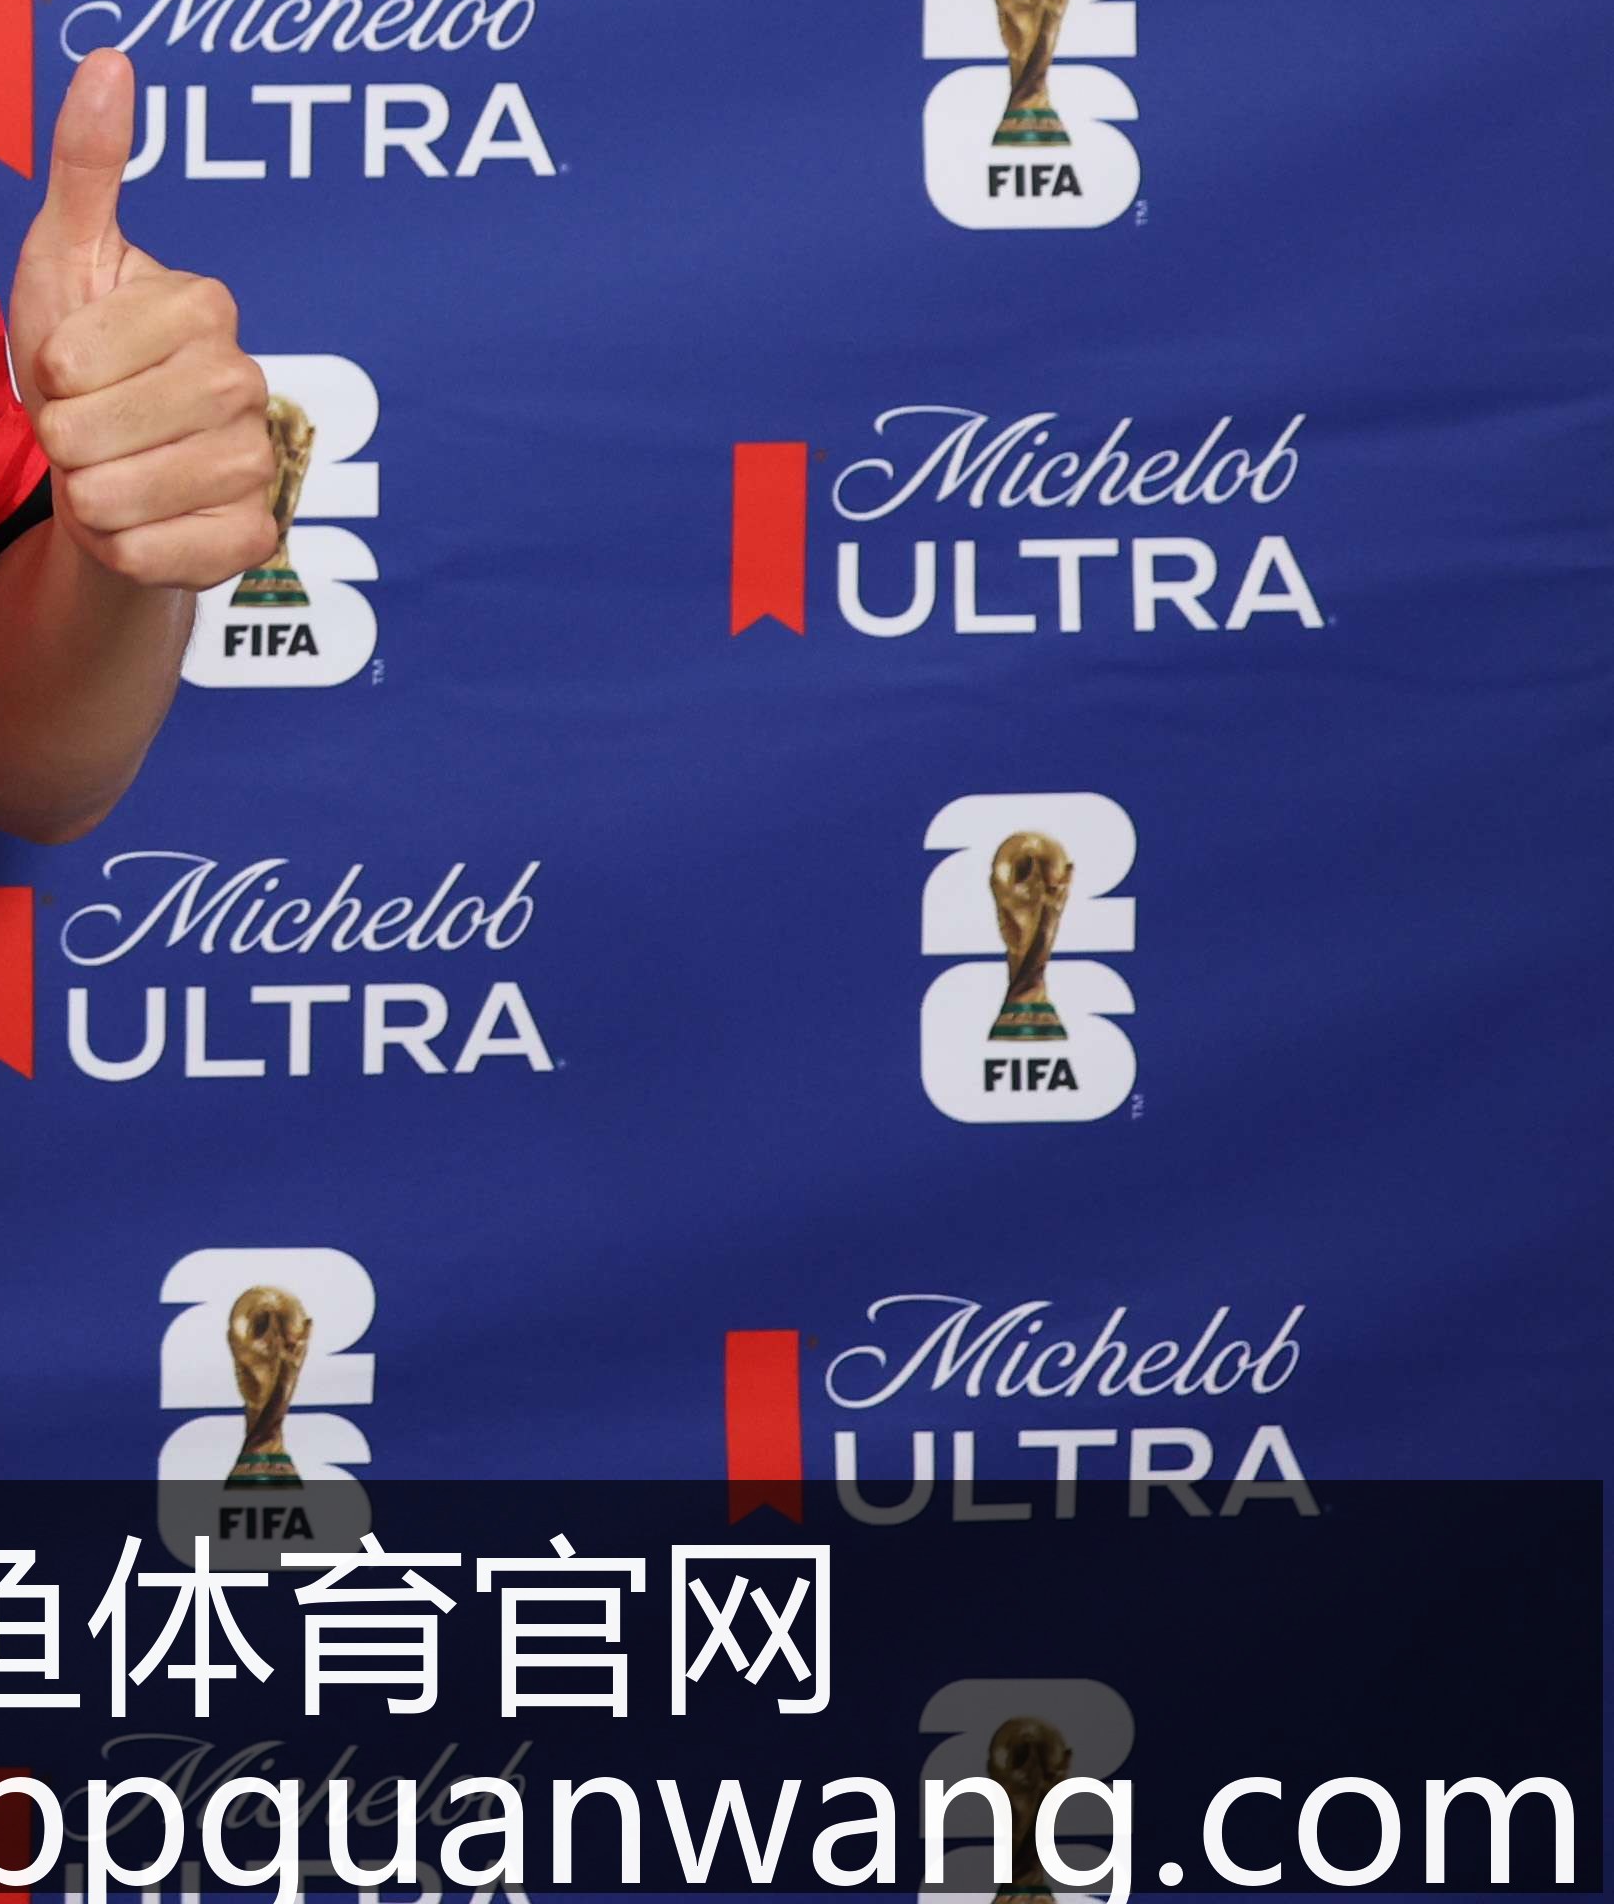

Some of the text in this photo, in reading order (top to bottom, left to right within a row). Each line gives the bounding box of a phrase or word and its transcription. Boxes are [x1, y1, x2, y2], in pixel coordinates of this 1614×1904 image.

[988, 164, 1082, 198] FIFA
[832, 405, 1305, 521] Michelob
[837, 535, 1324, 638] ULTRA
[224, 623, 319, 657] FIFA
[61, 850, 541, 966] Michelob
[68, 982, 554, 1082] ULTRA
[984, 1058, 1079, 1092] FIFA
[825, 1300, 1305, 1409] Michelob
[219, 1507, 315, 1539] FIFA
[834, 1425, 1320, 1525] ULTRA
